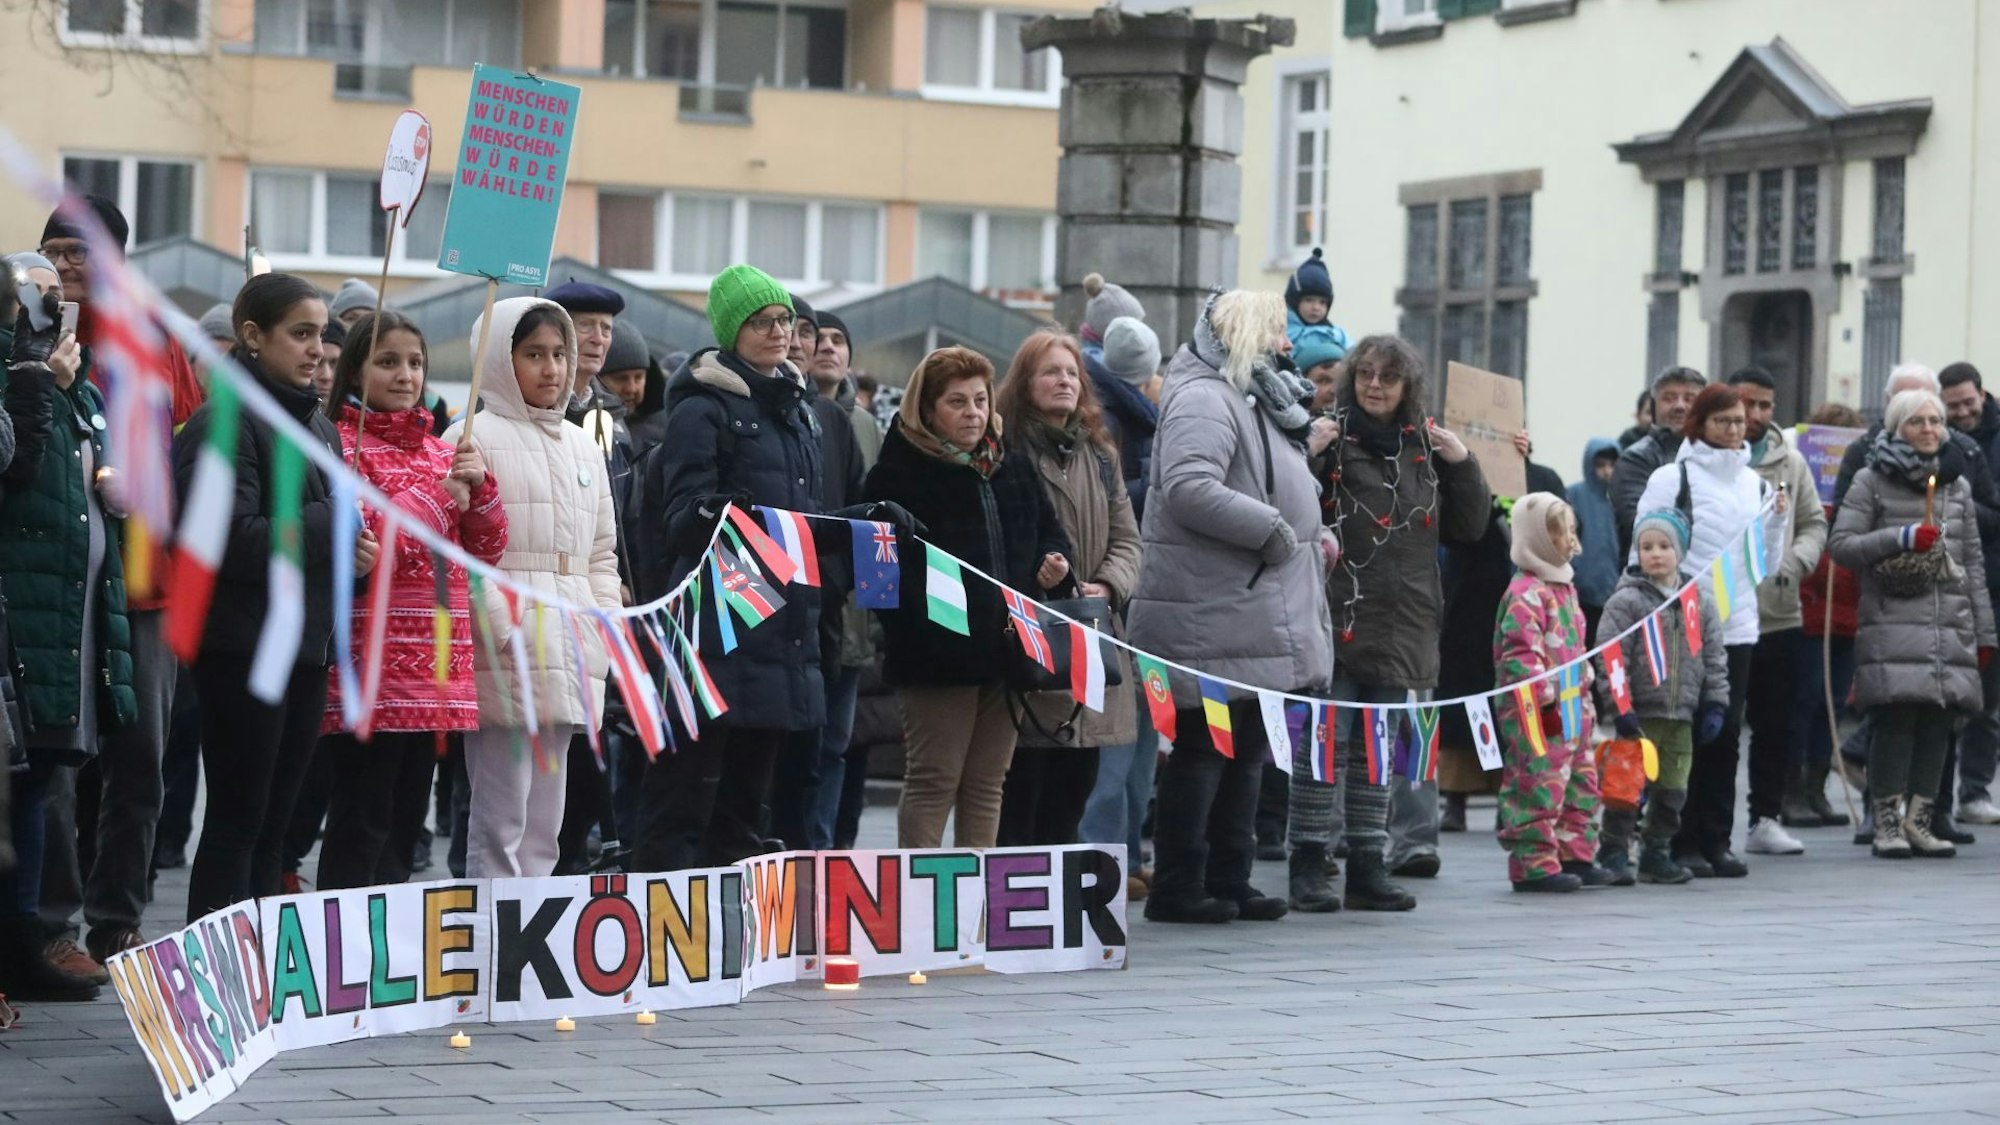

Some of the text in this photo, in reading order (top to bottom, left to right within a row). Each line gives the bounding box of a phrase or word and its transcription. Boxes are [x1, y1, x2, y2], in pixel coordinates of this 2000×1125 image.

[477, 79, 569, 117] MENSCHEN
[473, 101, 564, 138] WÜRDEN
[469, 123, 561, 158] MENSCHEN-
[466, 146, 557, 182] WÜRDE
[461, 168, 554, 204] WÄHLEN!
[511, 263, 524, 272] PRO
[524, 265, 541, 277] ASYL
[271, 885, 479, 1024] ALLE
